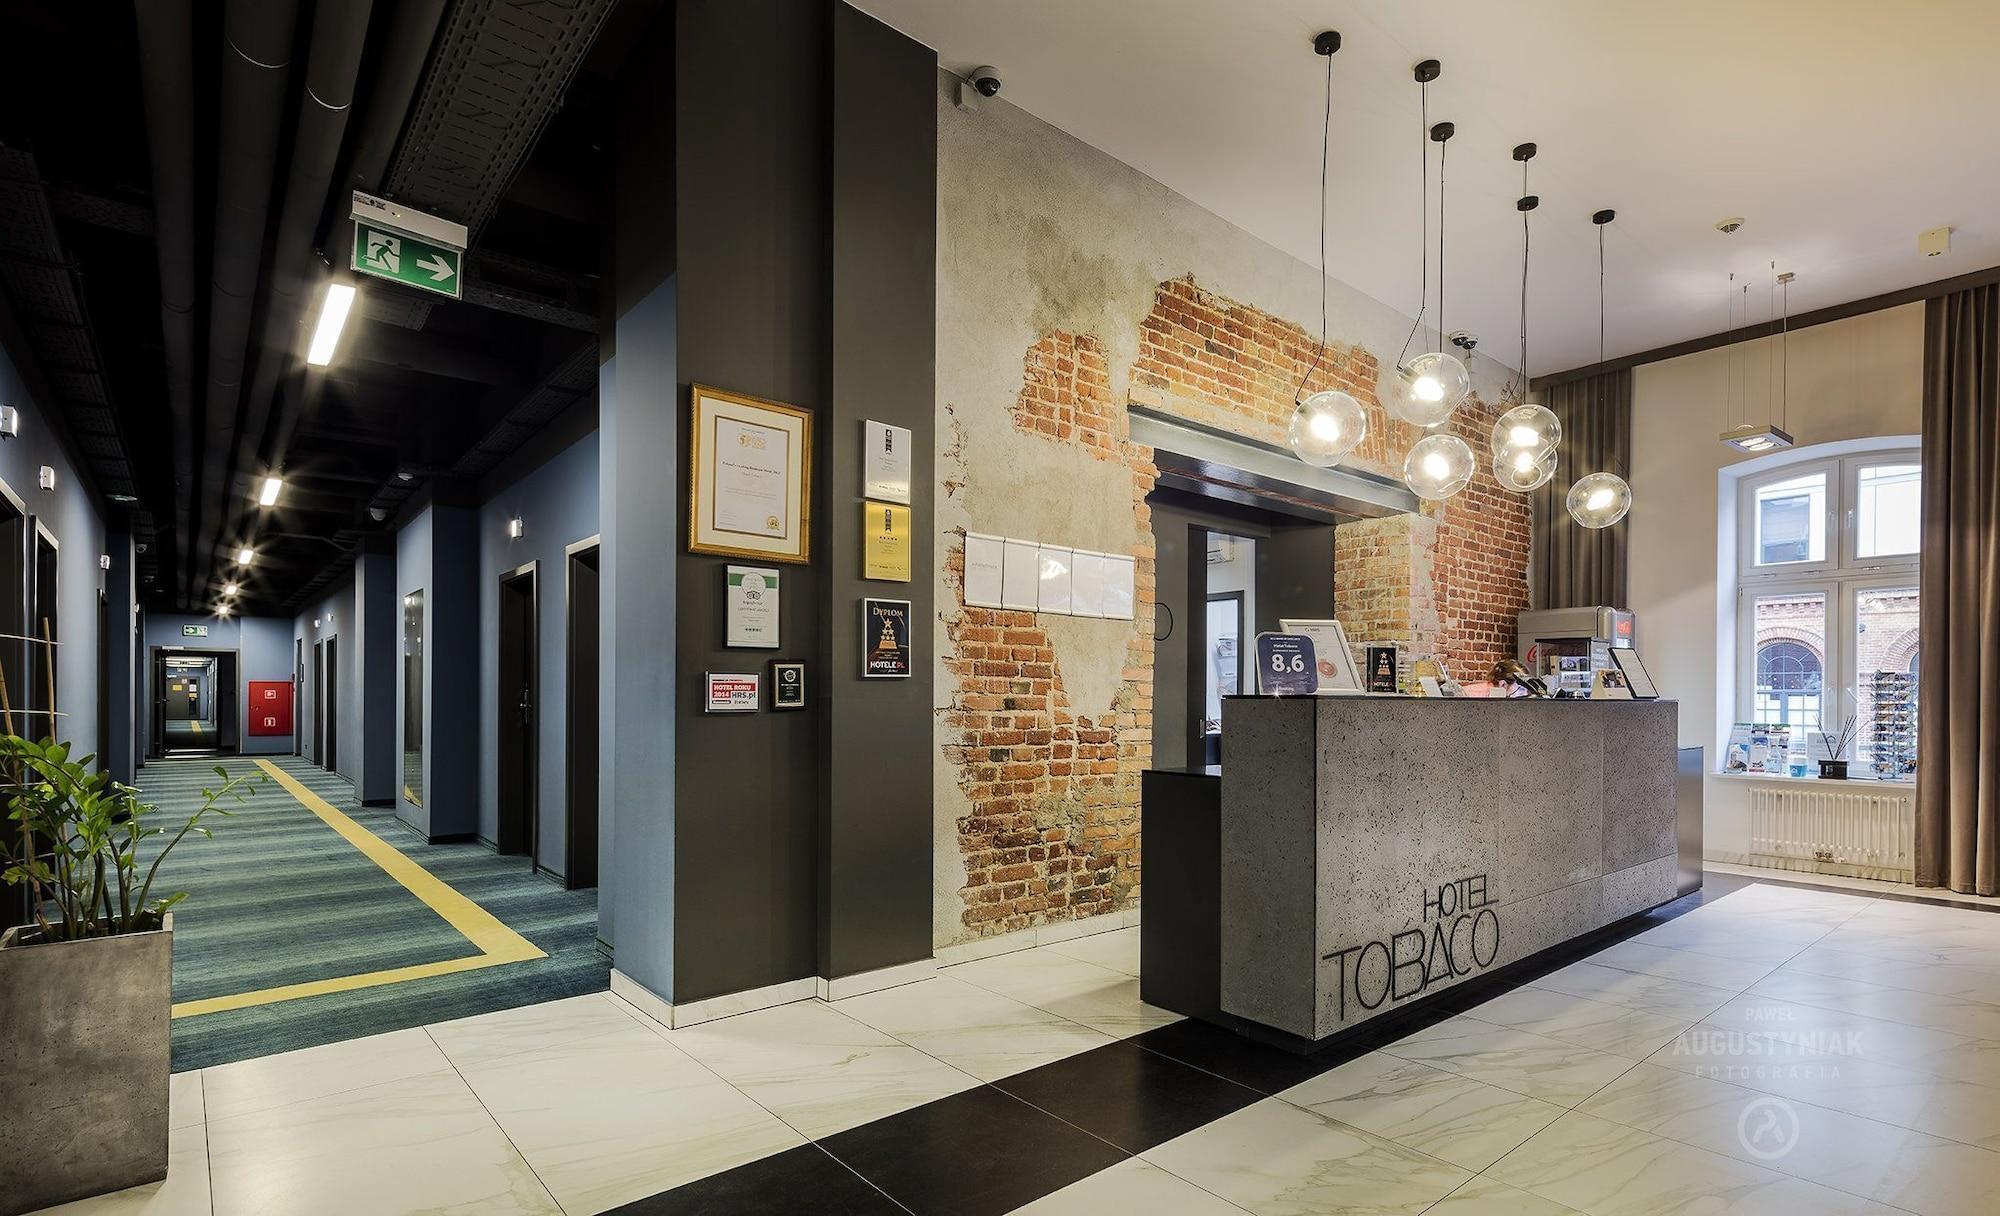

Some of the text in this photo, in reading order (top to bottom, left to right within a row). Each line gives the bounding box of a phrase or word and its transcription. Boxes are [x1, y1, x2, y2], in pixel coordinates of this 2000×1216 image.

[873, 608, 903, 617] DYPLOM
[1272, 654, 1305, 673] 8,6
[731, 691, 756, 699] HRS.pl
[1423, 874, 1499, 923] HOTEL
[1322, 909, 1499, 1021] TOBACO
